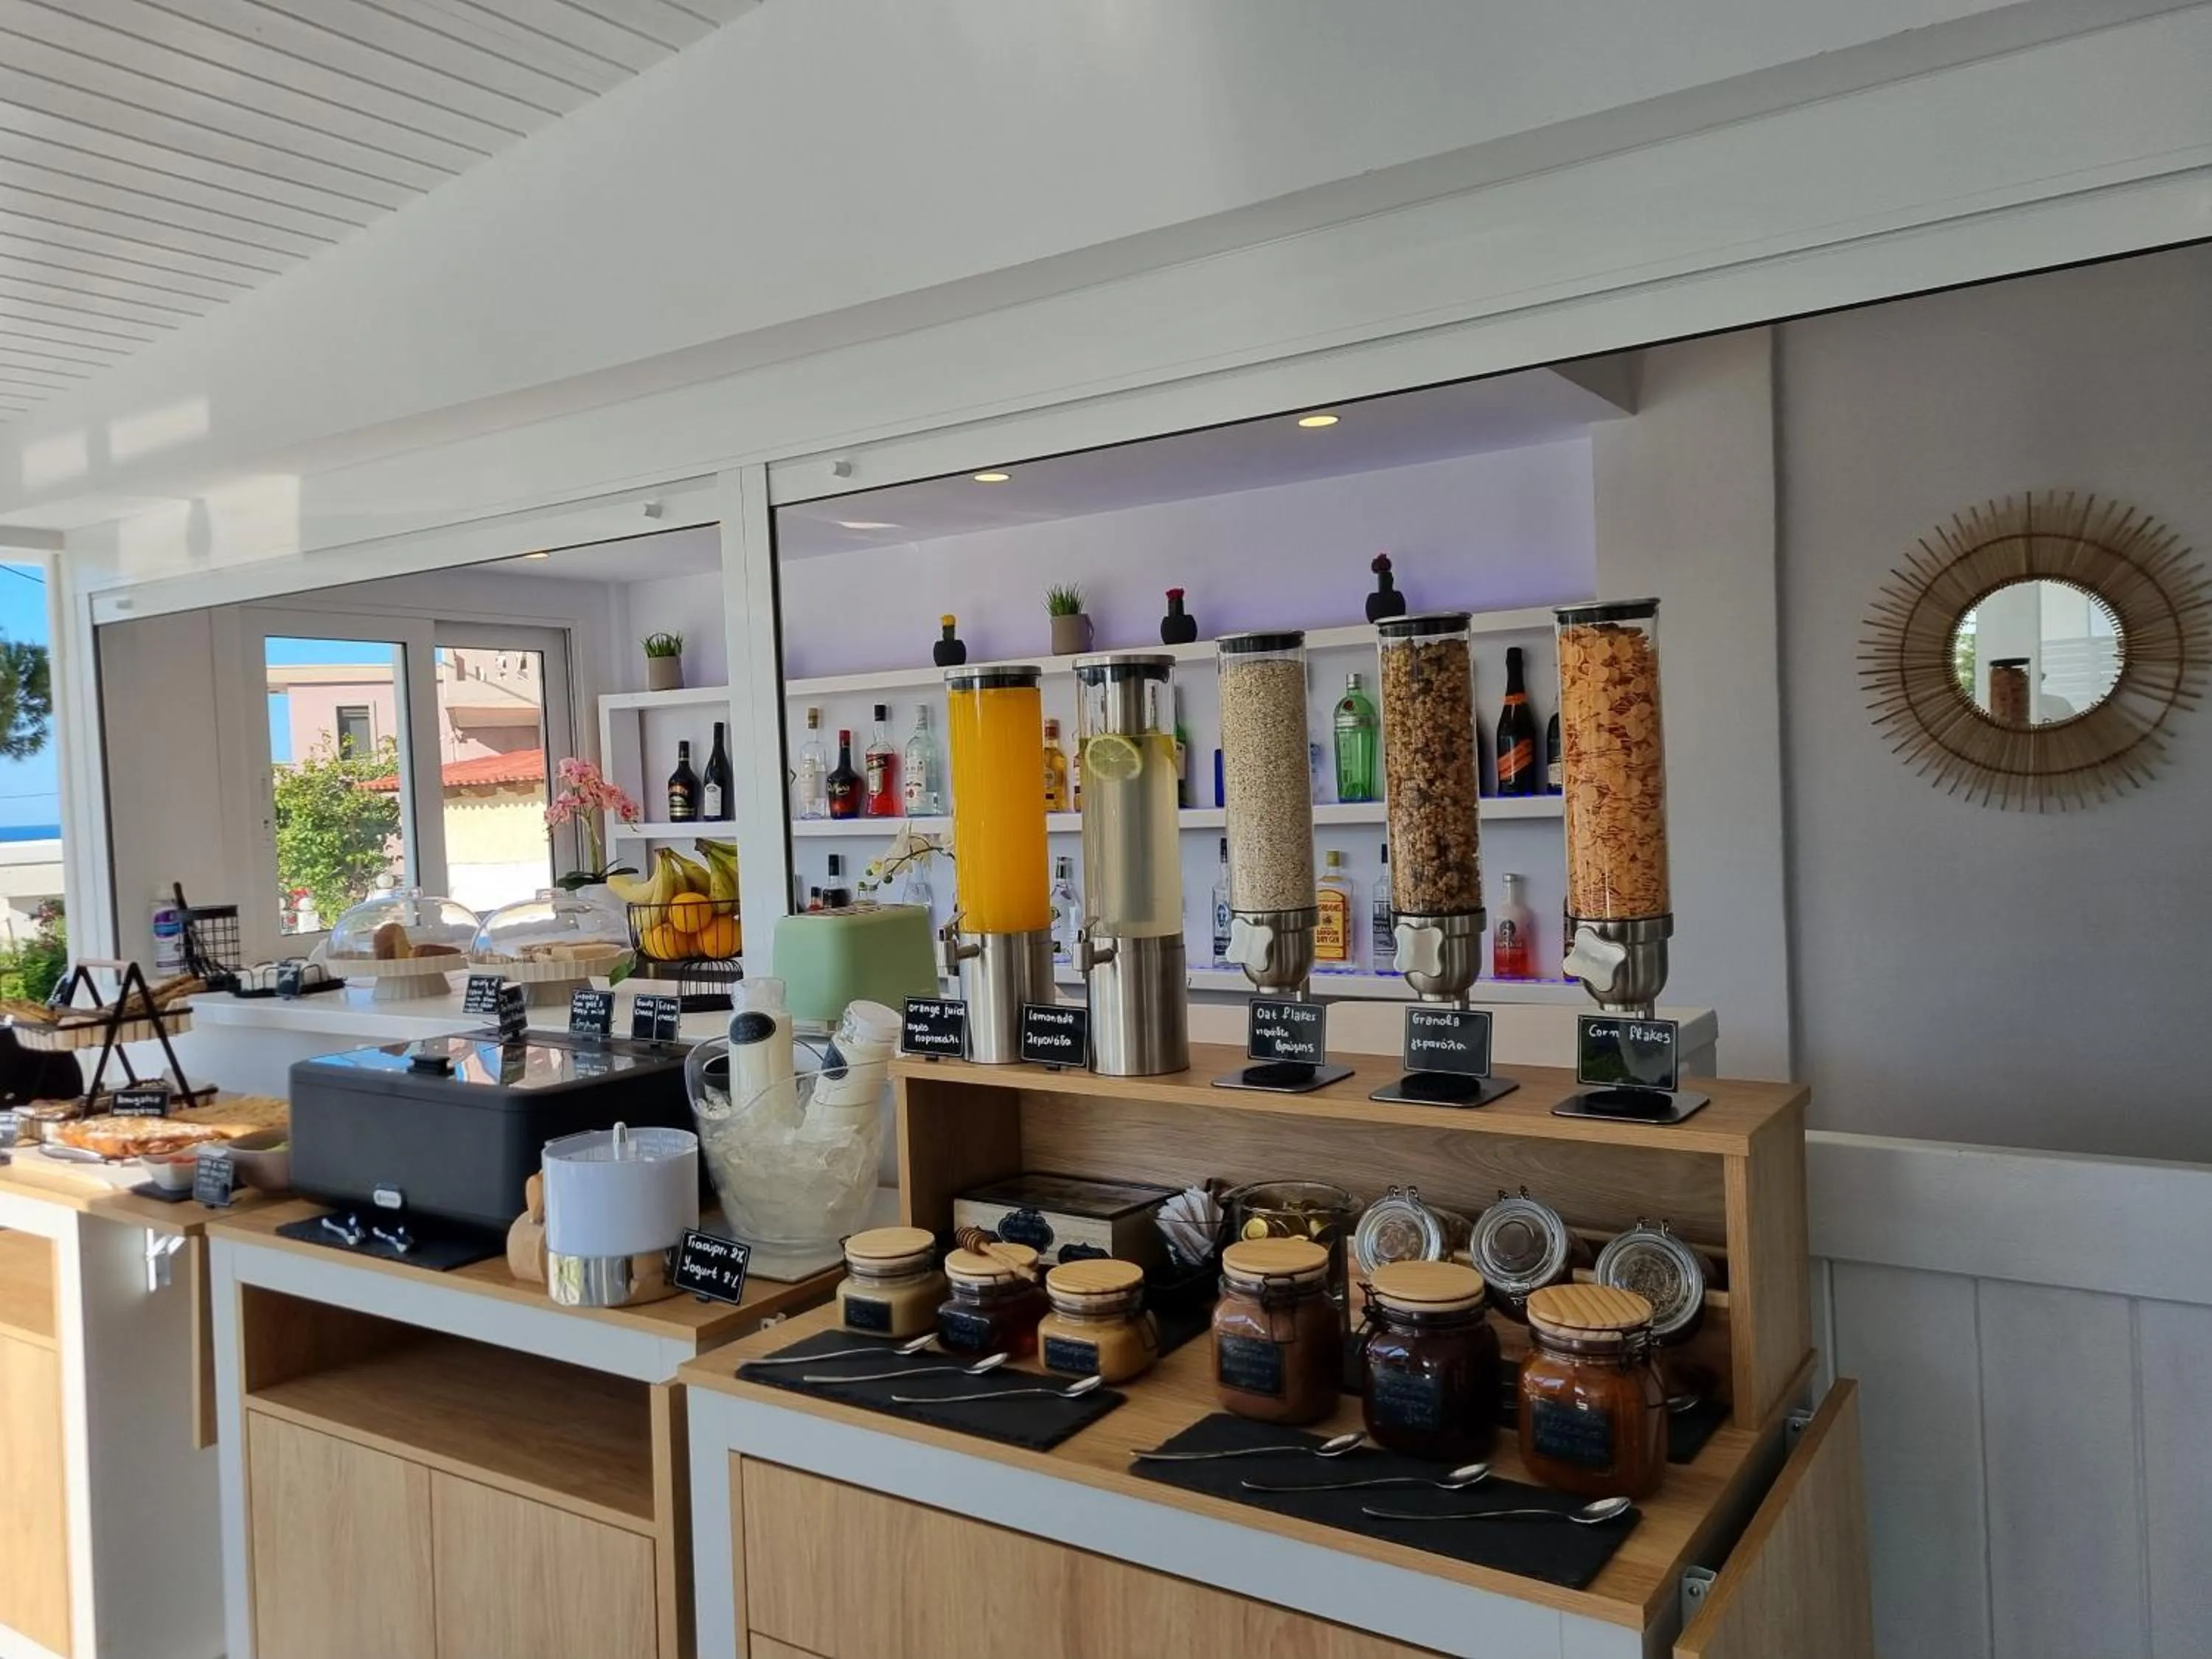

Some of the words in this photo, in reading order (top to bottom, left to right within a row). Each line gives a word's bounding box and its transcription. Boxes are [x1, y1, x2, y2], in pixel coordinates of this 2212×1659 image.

[908, 1004, 940, 1018] orange
[1256, 1007, 1277, 1020] Oat
[1412, 1012, 1460, 1027] Granola
[1589, 1023, 1620, 1038] Corn
[682, 1254, 717, 1280] Yogurt
